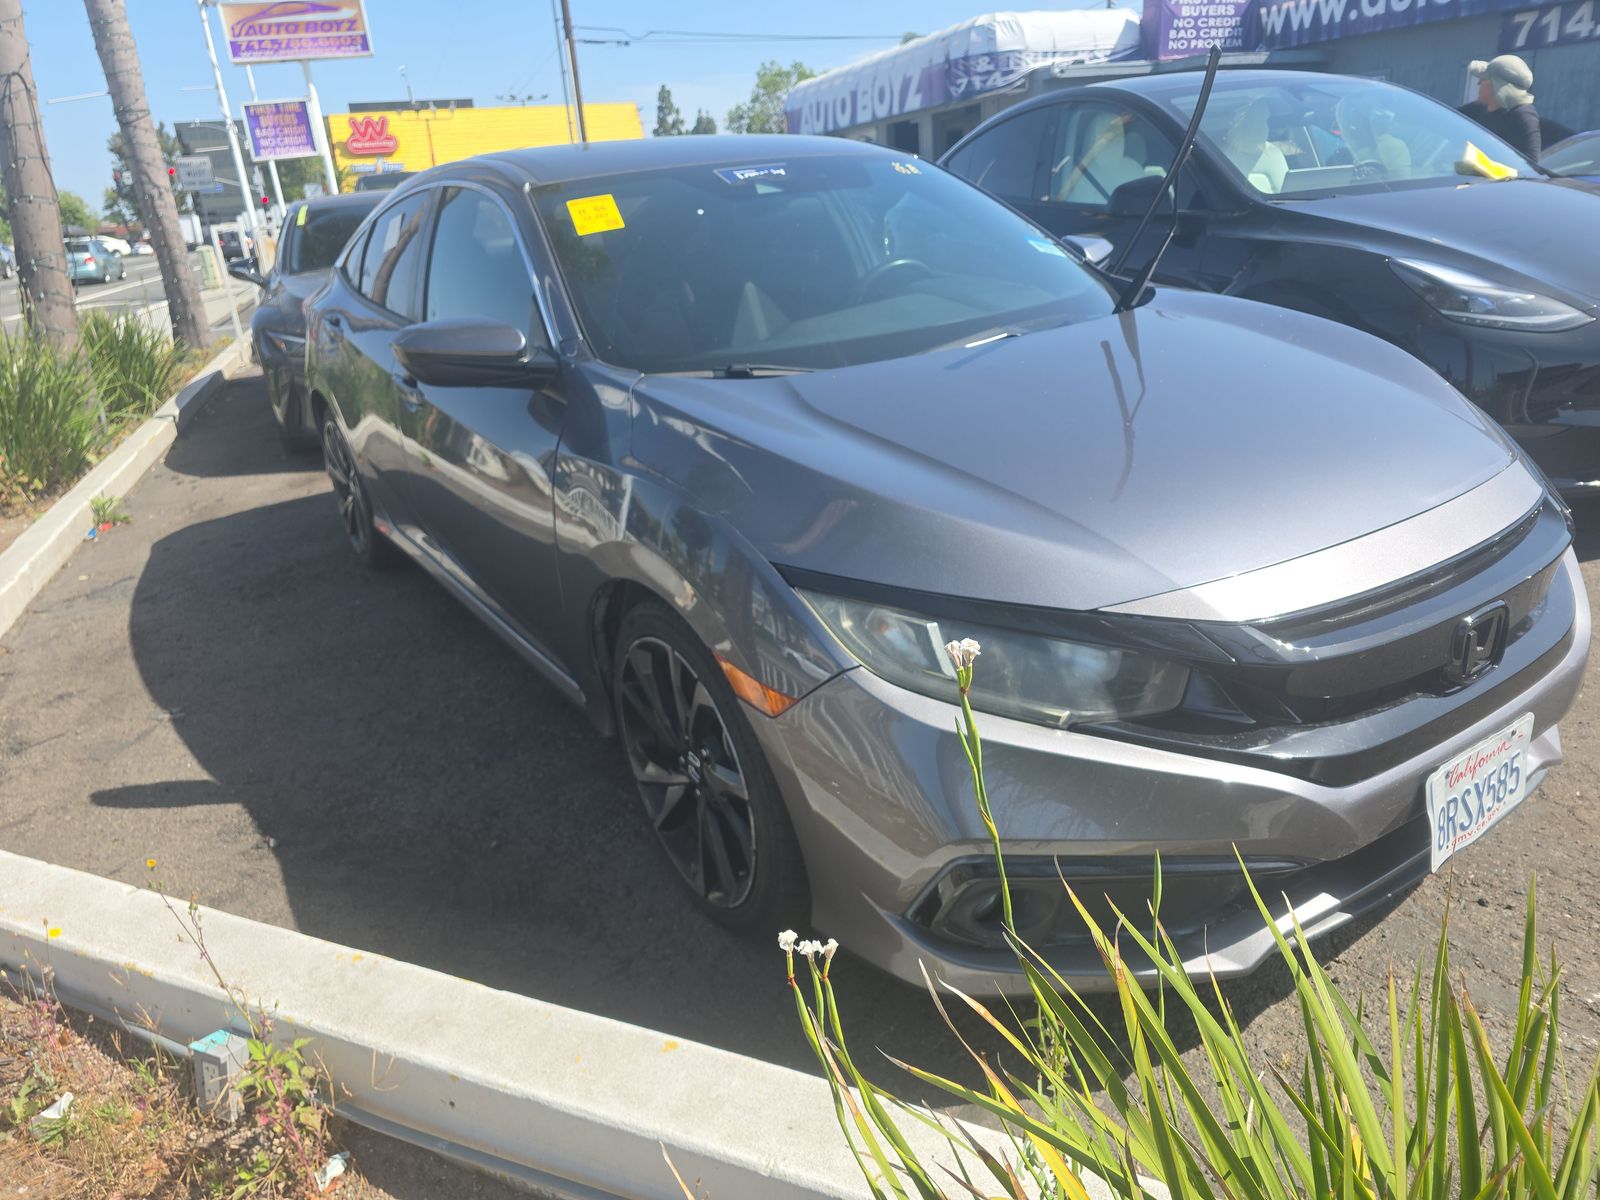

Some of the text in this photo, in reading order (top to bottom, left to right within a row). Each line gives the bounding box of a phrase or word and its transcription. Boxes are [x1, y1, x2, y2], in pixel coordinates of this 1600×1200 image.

[1181, 5, 1236, 17] BUYERS
[245, 20, 358, 36] AUTO BOYZ
[1173, 17, 1241, 28] NO CREDIT
[1169, 27, 1243, 39] BAD CREDIT
[1168, 39, 1188, 50] NO
[801, 69, 923, 135] AUTO BOYZ
[1449, 740, 1512, 789] California
[1437, 752, 1521, 851] 8RSX585
